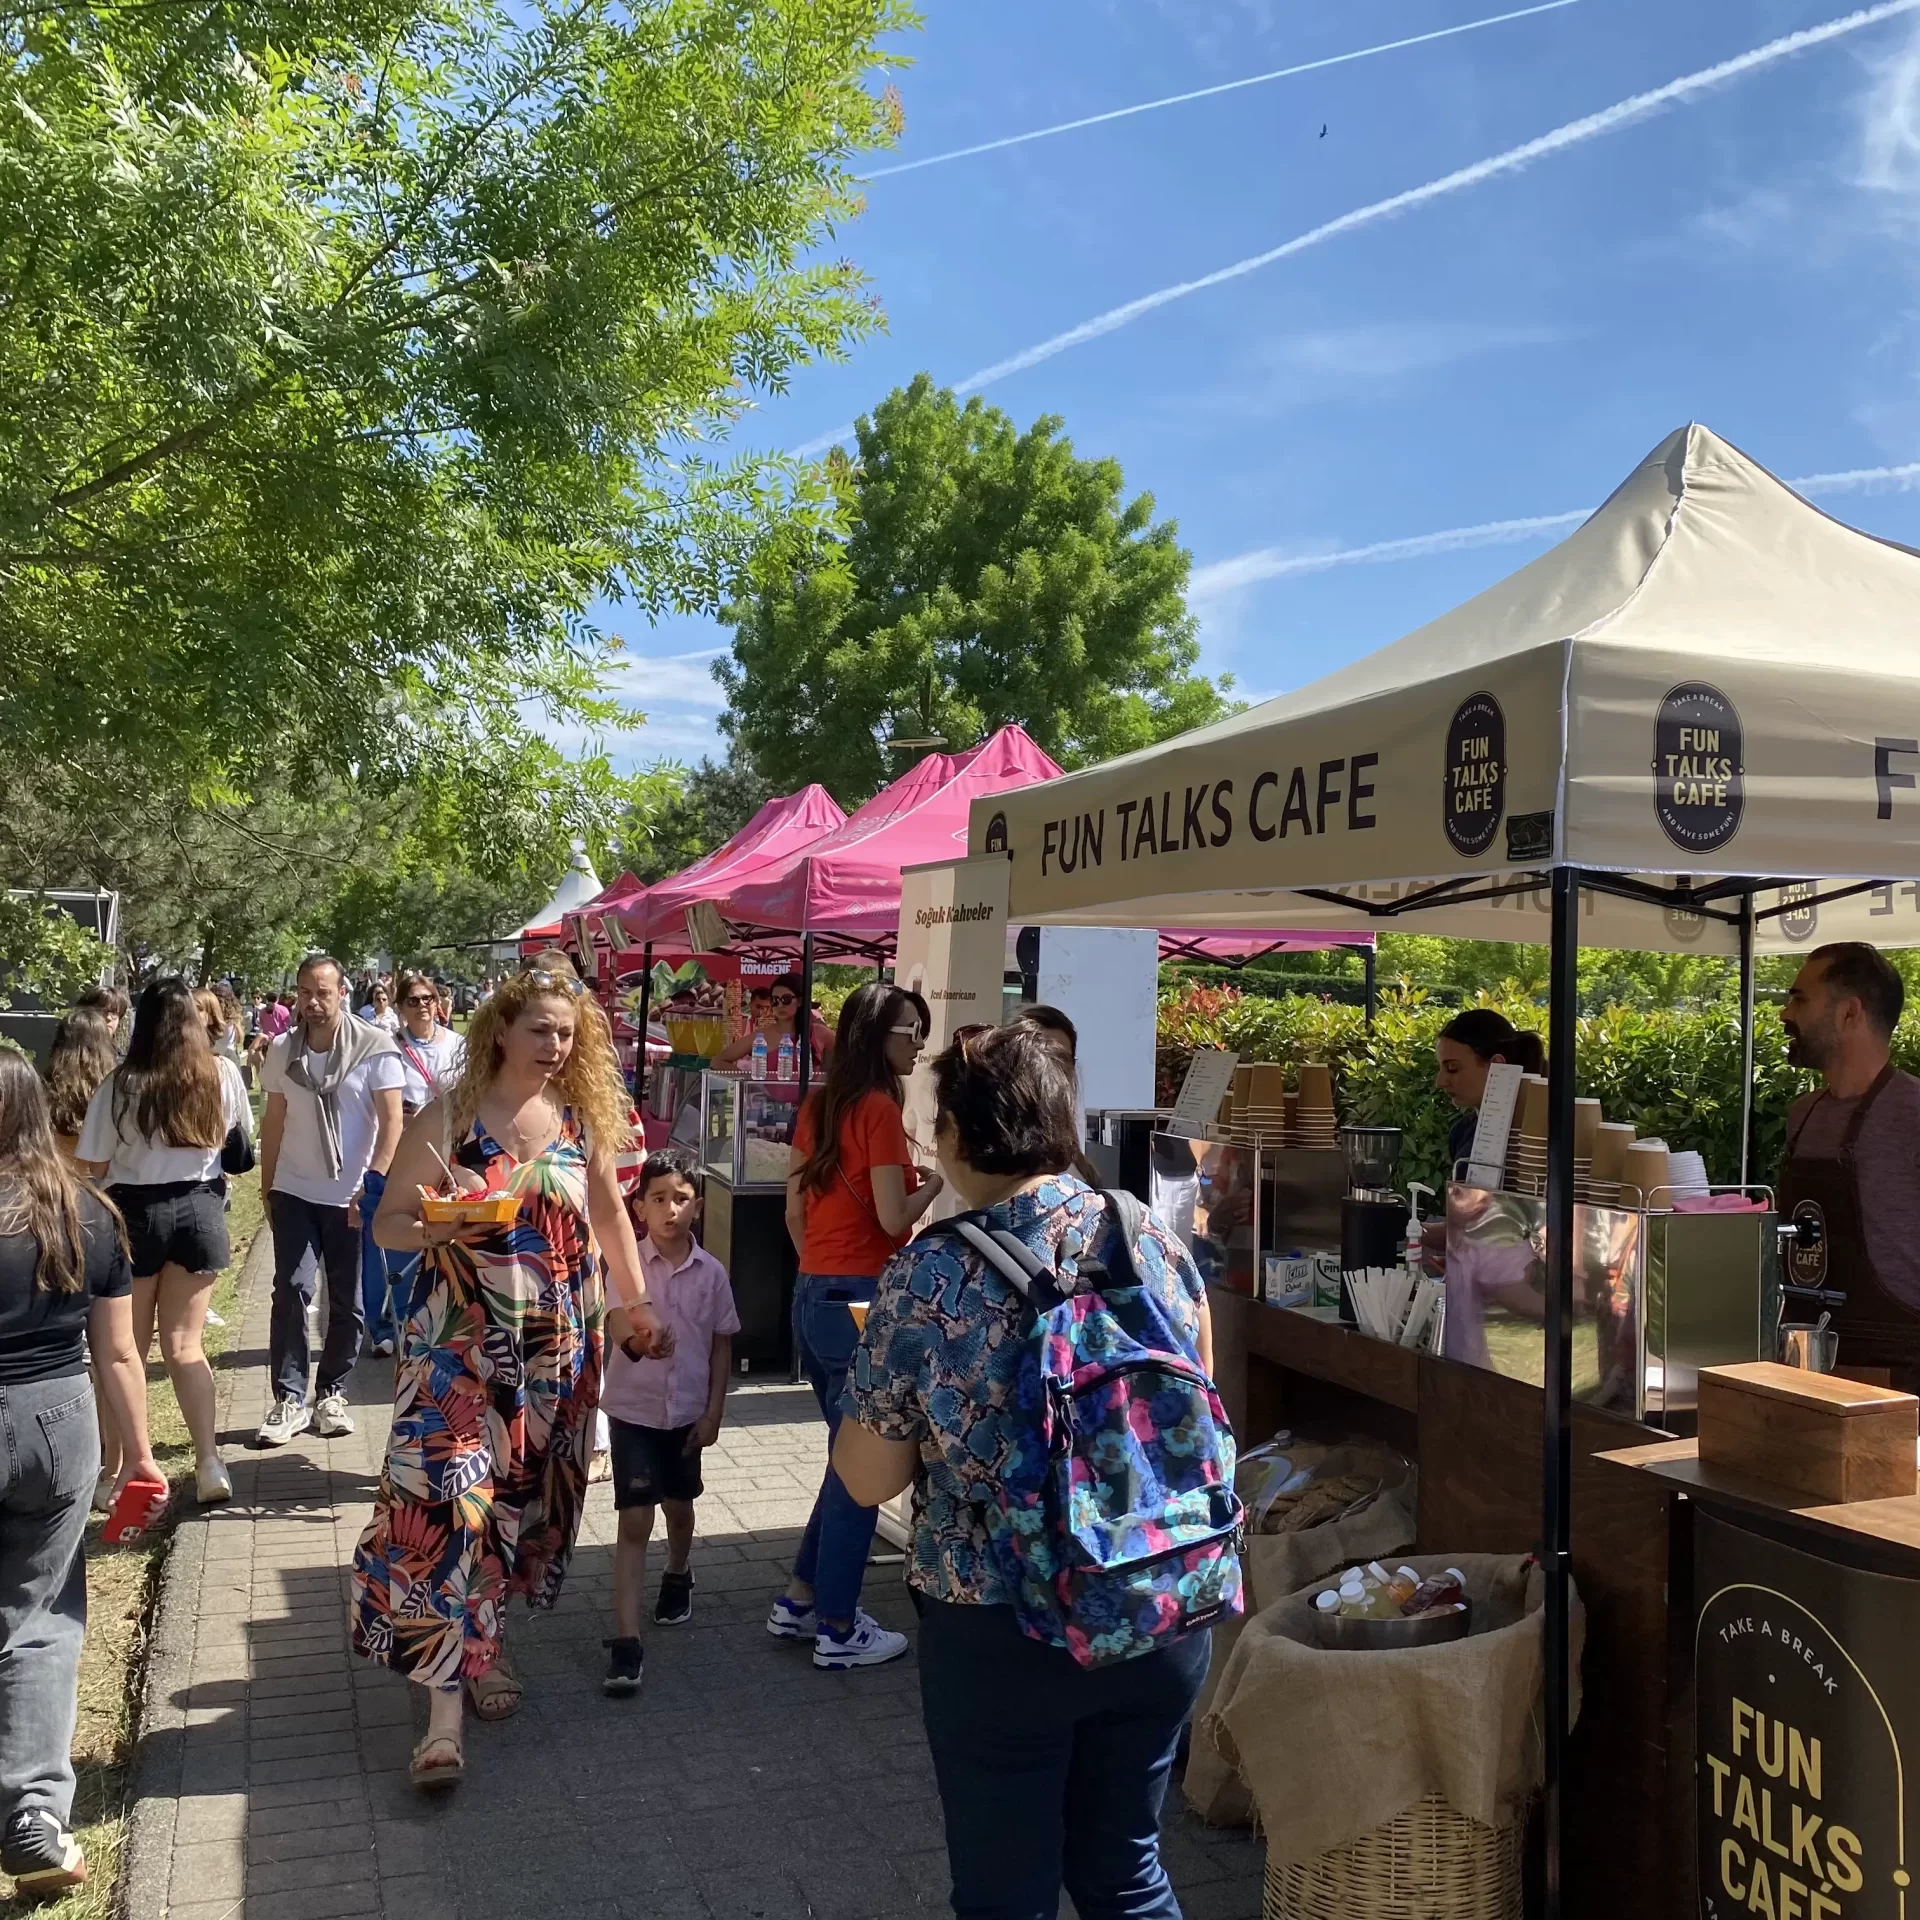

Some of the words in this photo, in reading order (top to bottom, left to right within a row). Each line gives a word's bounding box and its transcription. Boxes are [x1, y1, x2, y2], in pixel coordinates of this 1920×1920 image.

[1672, 694, 1691, 708] TAKE
[1699, 694, 1724, 712] BREAK
[1461, 736, 1489, 762] FUN
[1679, 727, 1720, 753] FUN
[1452, 761, 1499, 788] TALKS
[1665, 754, 1733, 782] TALKS
[1455, 783, 1492, 813] CAFÉ
[1673, 779, 1727, 807] CAFÉ
[1041, 808, 1105, 876] FUN
[1116, 779, 1233, 862] TALKS
[1248, 752, 1379, 842] CAFE
[1662, 808, 1677, 826] AND
[1675, 824, 1697, 840] HAVE
[1698, 828, 1721, 840] SOME
[915, 906, 946, 929] Soğuk
[946, 902, 994, 924] Kahveler
[740, 964, 791, 975] KOMAGENE
[1719, 1617, 1754, 1643] TAKE
[1761, 1620, 1772, 1637] A
[1781, 1628, 1838, 1695] BREAK
[1732, 1696, 1821, 1800] FUN
[1706, 1752, 1863, 1892] TALKS
